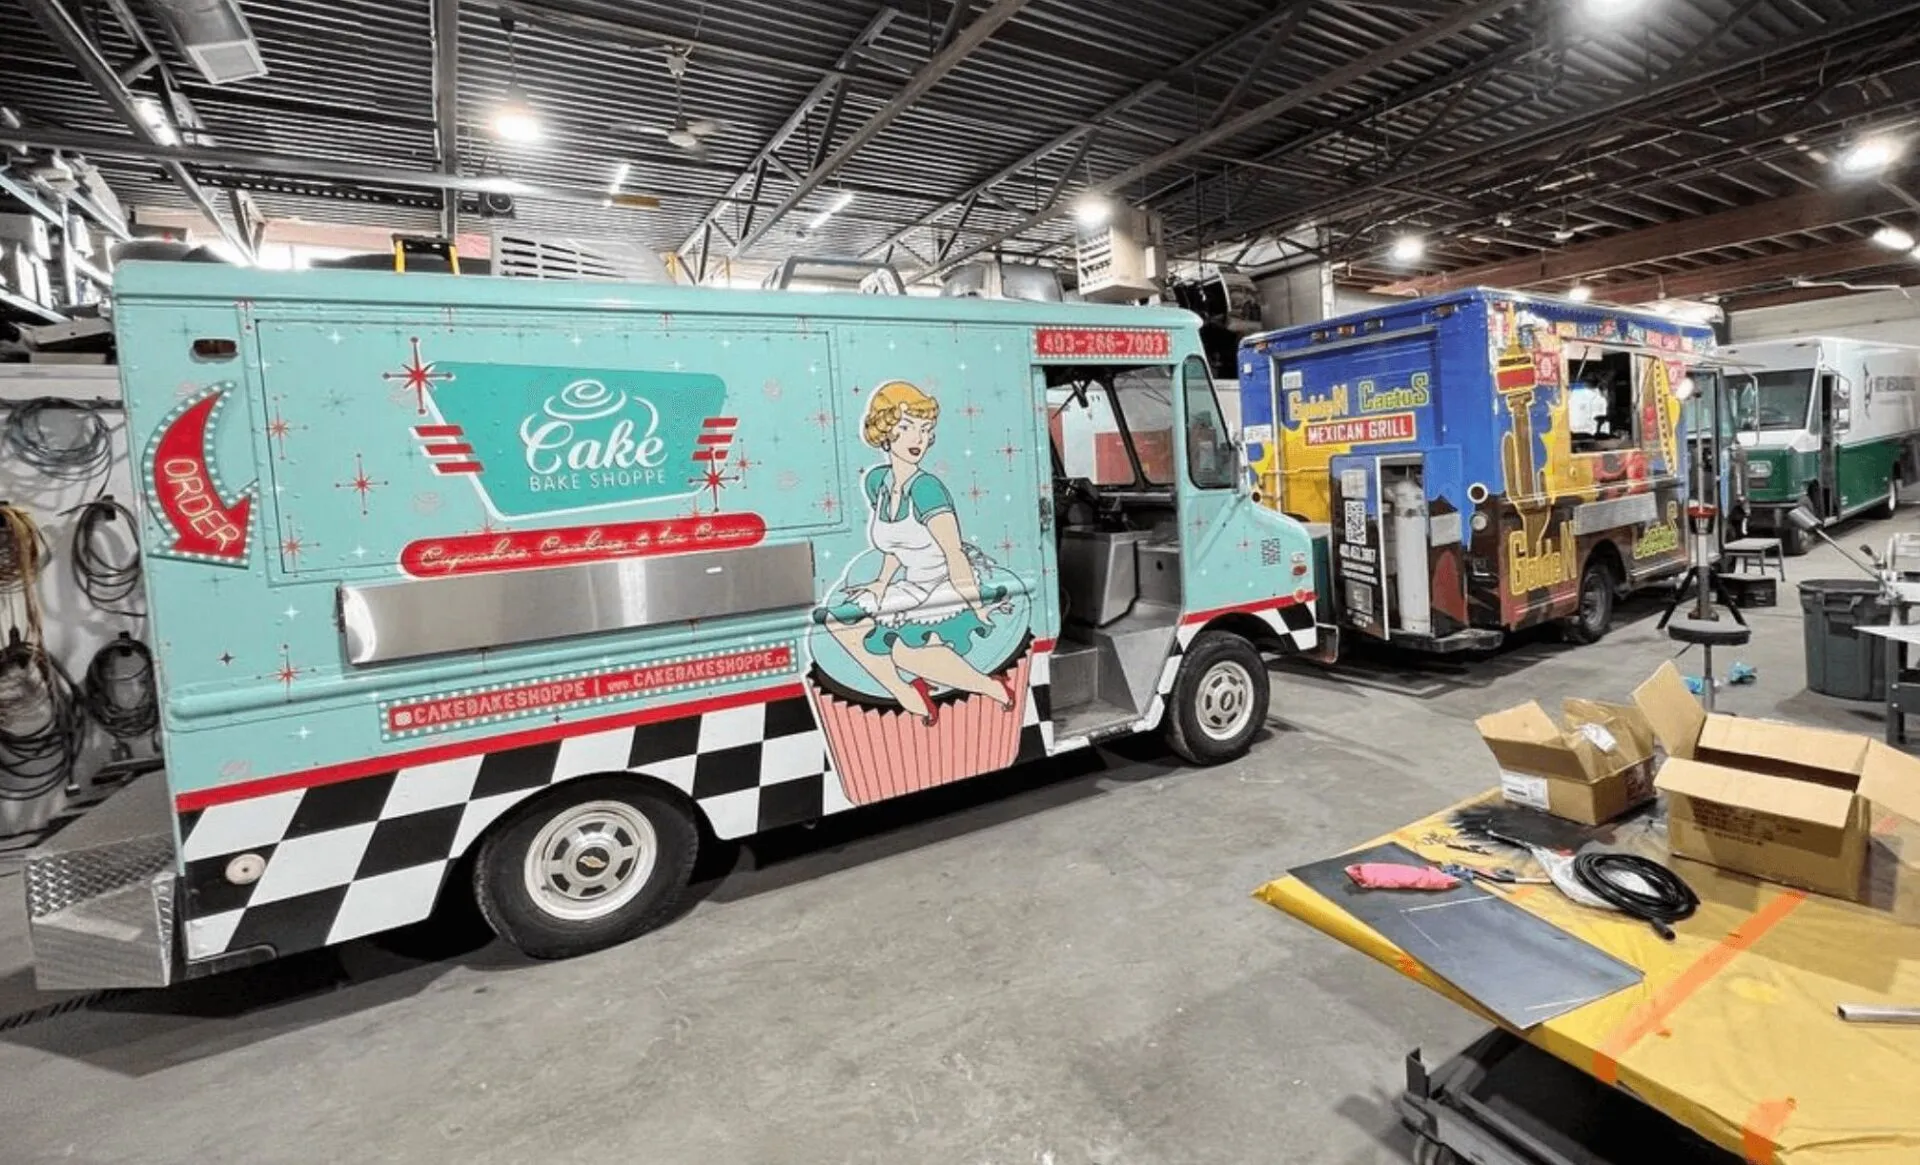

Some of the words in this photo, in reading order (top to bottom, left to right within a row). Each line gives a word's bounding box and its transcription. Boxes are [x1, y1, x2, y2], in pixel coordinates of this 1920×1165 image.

[520, 412, 668, 474] Cake
[1307, 422, 1364, 445] MEXICAN
[1368, 417, 1408, 438] GRILL
[530, 474, 581, 492] BAKE
[590, 469, 665, 488] SHOPPE
[164, 458, 240, 551] ORDER
[413, 680, 586, 724] CAKEBAKESHOPPE
